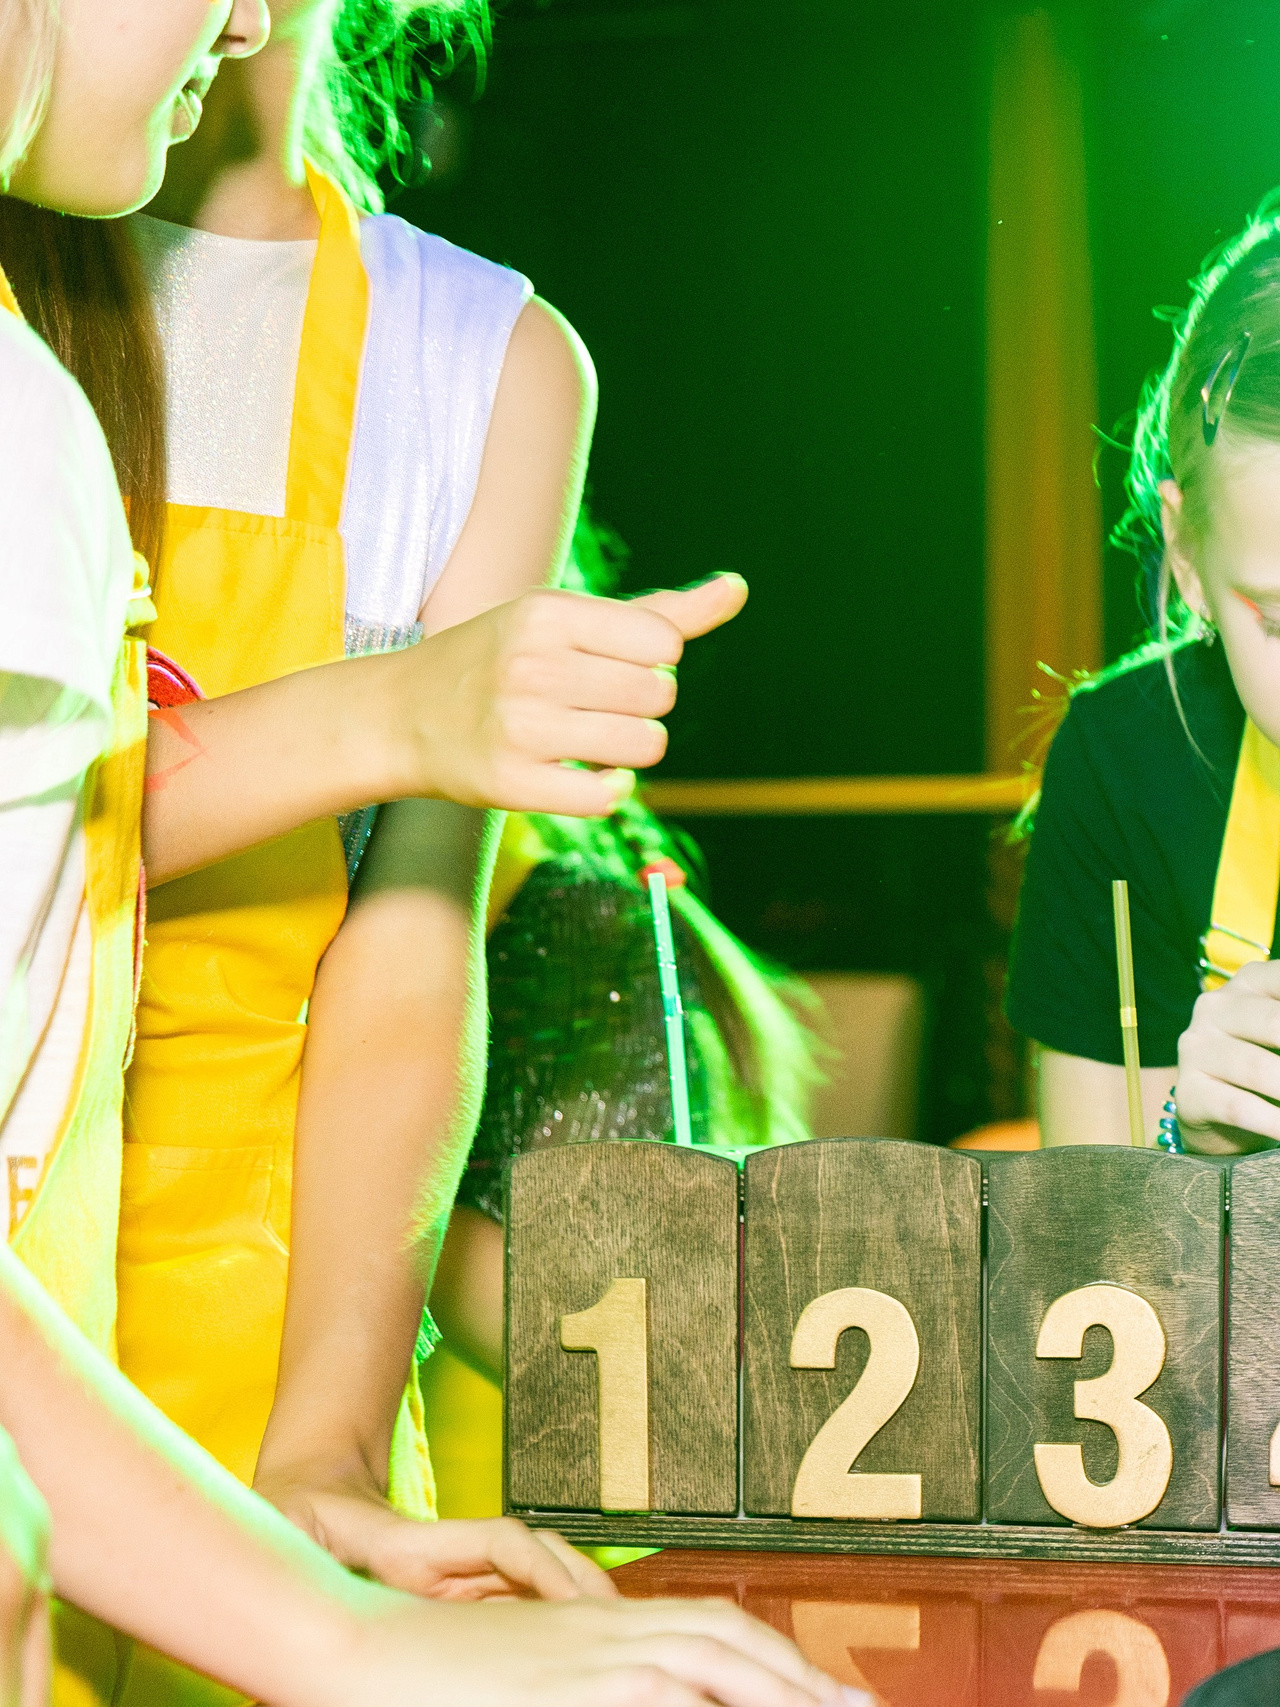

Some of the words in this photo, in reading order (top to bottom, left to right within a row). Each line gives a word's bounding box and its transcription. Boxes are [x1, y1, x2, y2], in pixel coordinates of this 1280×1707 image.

[560, 1277, 649, 1513] 1
[790, 1287, 922, 1519] 2
[1033, 1283, 1173, 1528] 3
